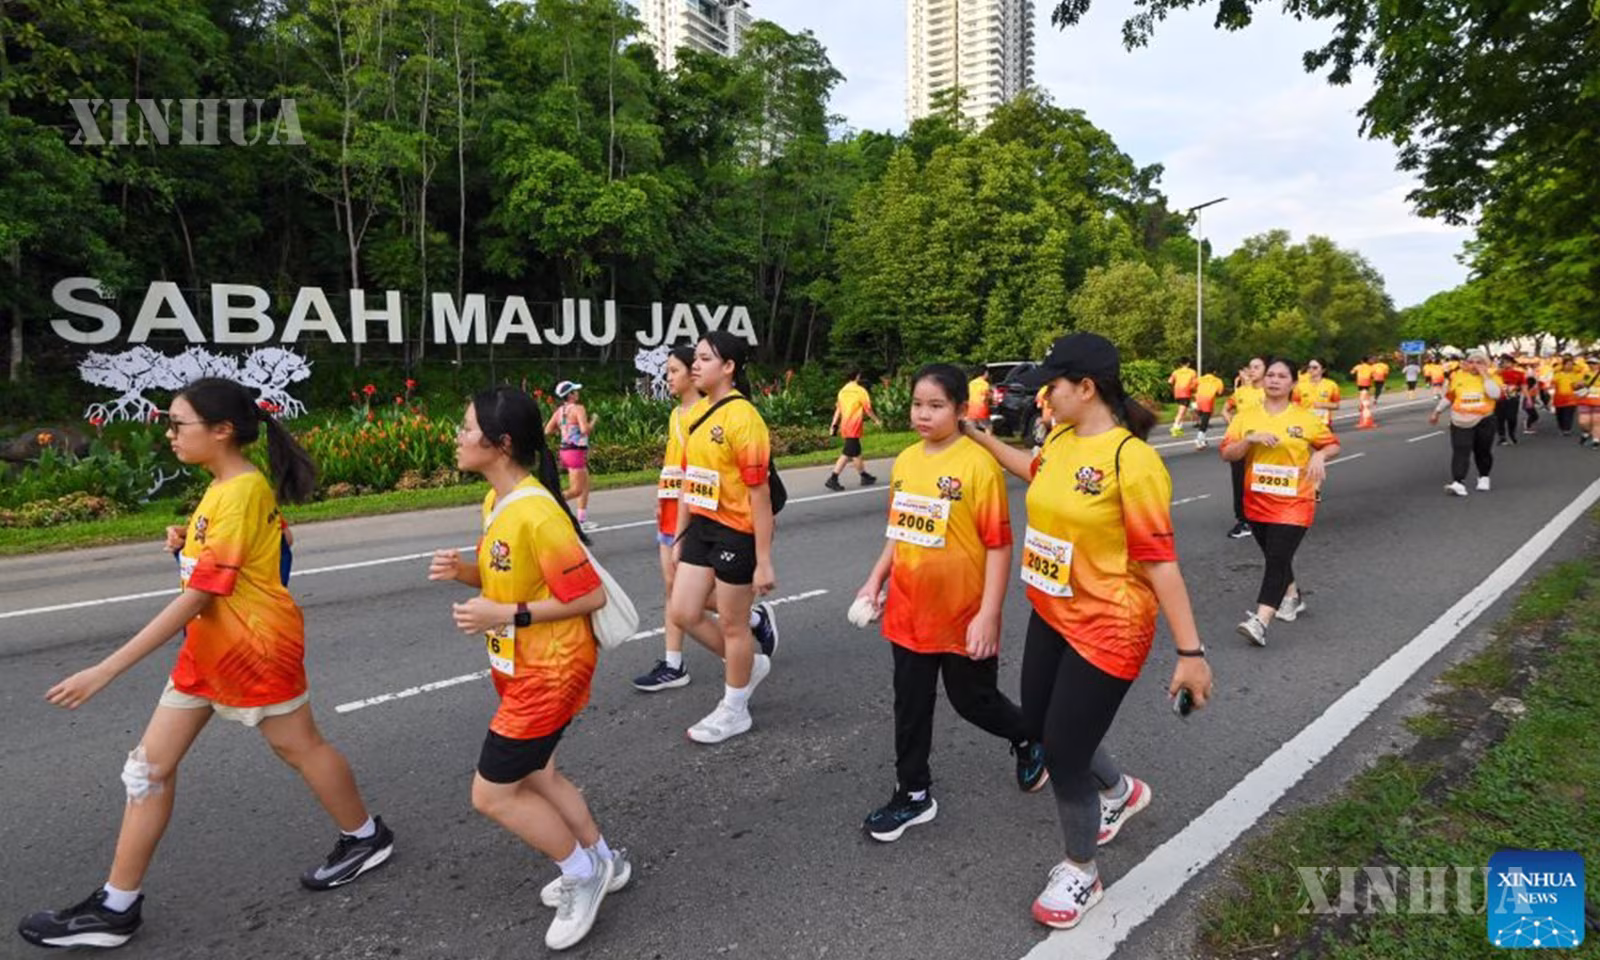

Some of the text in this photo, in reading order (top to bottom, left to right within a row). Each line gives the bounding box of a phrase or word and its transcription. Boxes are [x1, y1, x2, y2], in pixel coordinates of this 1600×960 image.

[50, 277, 759, 346] SABAH MAJU JAYA
[690, 482, 713, 498] 1484
[1259, 475, 1289, 487] 0203
[897, 512, 935, 533] 2006
[1028, 552, 1059, 580] 2032
